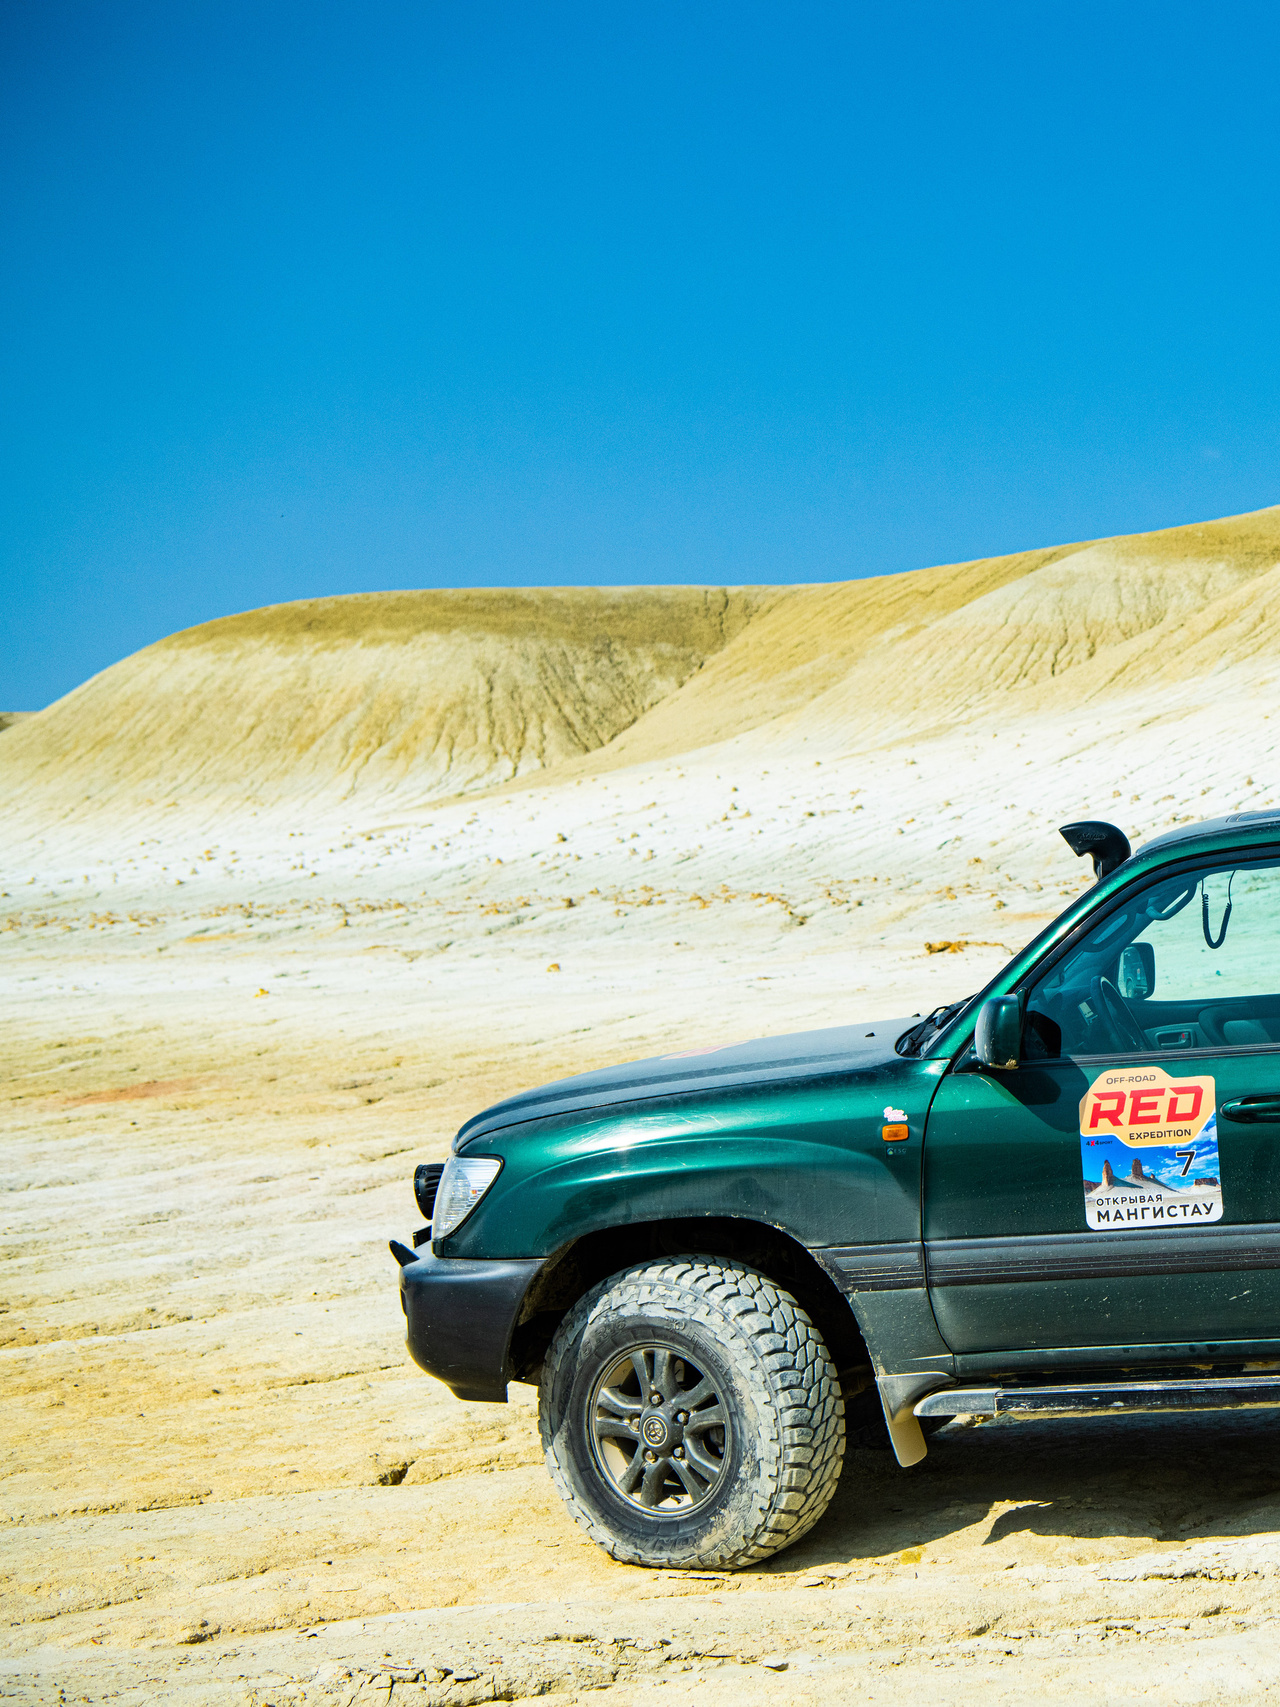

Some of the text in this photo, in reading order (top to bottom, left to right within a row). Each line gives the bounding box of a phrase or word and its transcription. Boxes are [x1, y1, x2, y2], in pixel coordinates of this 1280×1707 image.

[1106, 1074, 1157, 1085] OFF-ROAD
[1089, 1085, 1204, 1129] RED
[1129, 1128, 1192, 1141] EXPEDITION
[1175, 1150, 1196, 1177] 7
[1096, 1194, 1163, 1206] ОТКРЫВАЯ
[1097, 1202, 1214, 1223] МАНГИСТАУ
